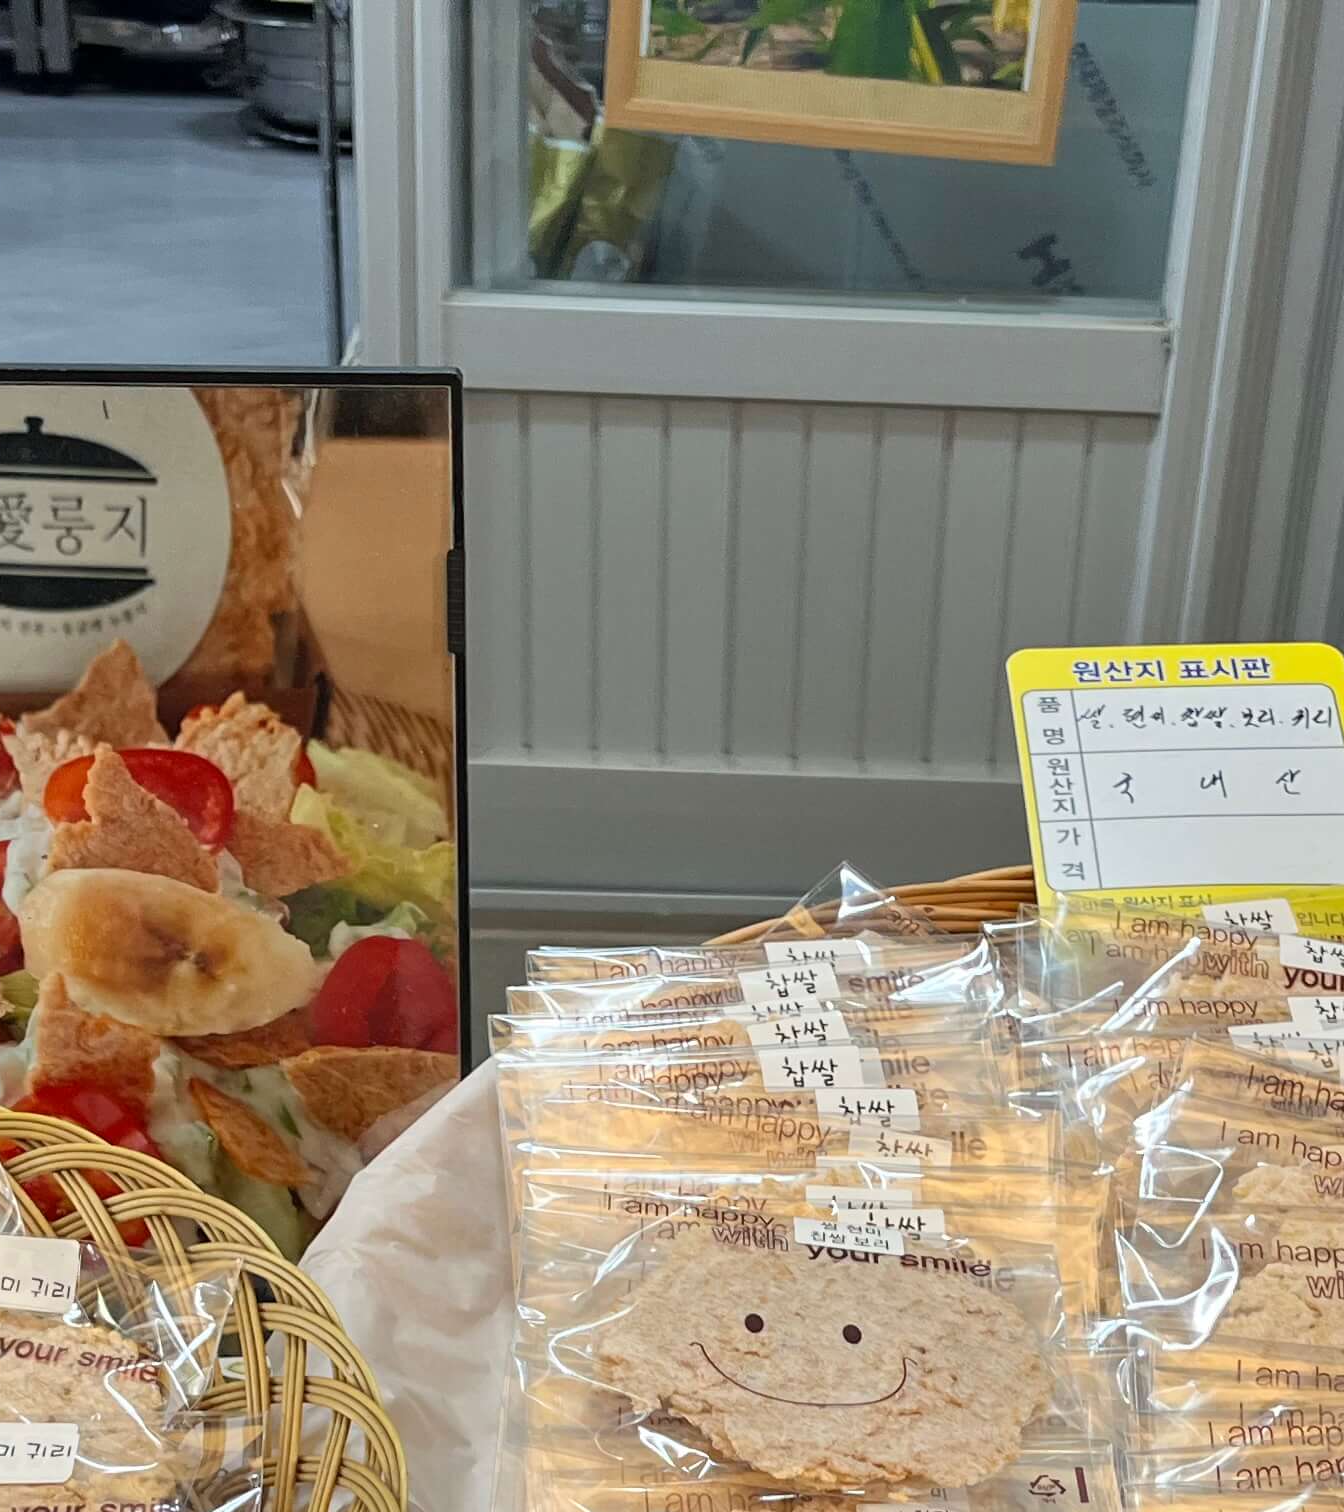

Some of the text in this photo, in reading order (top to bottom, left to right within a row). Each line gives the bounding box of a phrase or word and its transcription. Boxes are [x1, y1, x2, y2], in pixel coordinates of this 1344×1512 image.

[1072, 657, 1271, 682] 원산지 표시판
[1048, 758, 1076, 815] 원산지
[1131, 917, 1258, 950] am happy
[766, 970, 817, 997] 찹쌀
[1179, 997, 1258, 1022] happy
[775, 1019, 828, 1047] 찹쌀
[782, 1057, 838, 1087] 찹쌀
[1263, 1074, 1304, 1099] am
[839, 1096, 895, 1128] 찹쌀
[1221, 1120, 1226, 1141] I
[1237, 1129, 1280, 1149] am
[624, 1199, 775, 1227] am happy
[900, 1253, 991, 1277] smile
[31, 1276, 72, 1300] 귀리
[77, 1349, 160, 1384] smile
[1237, 1360, 1301, 1388] I am
[1209, 1421, 1274, 1449] I am
[26, 1441, 72, 1459] 귀리
[1216, 1464, 1283, 1493] I am
